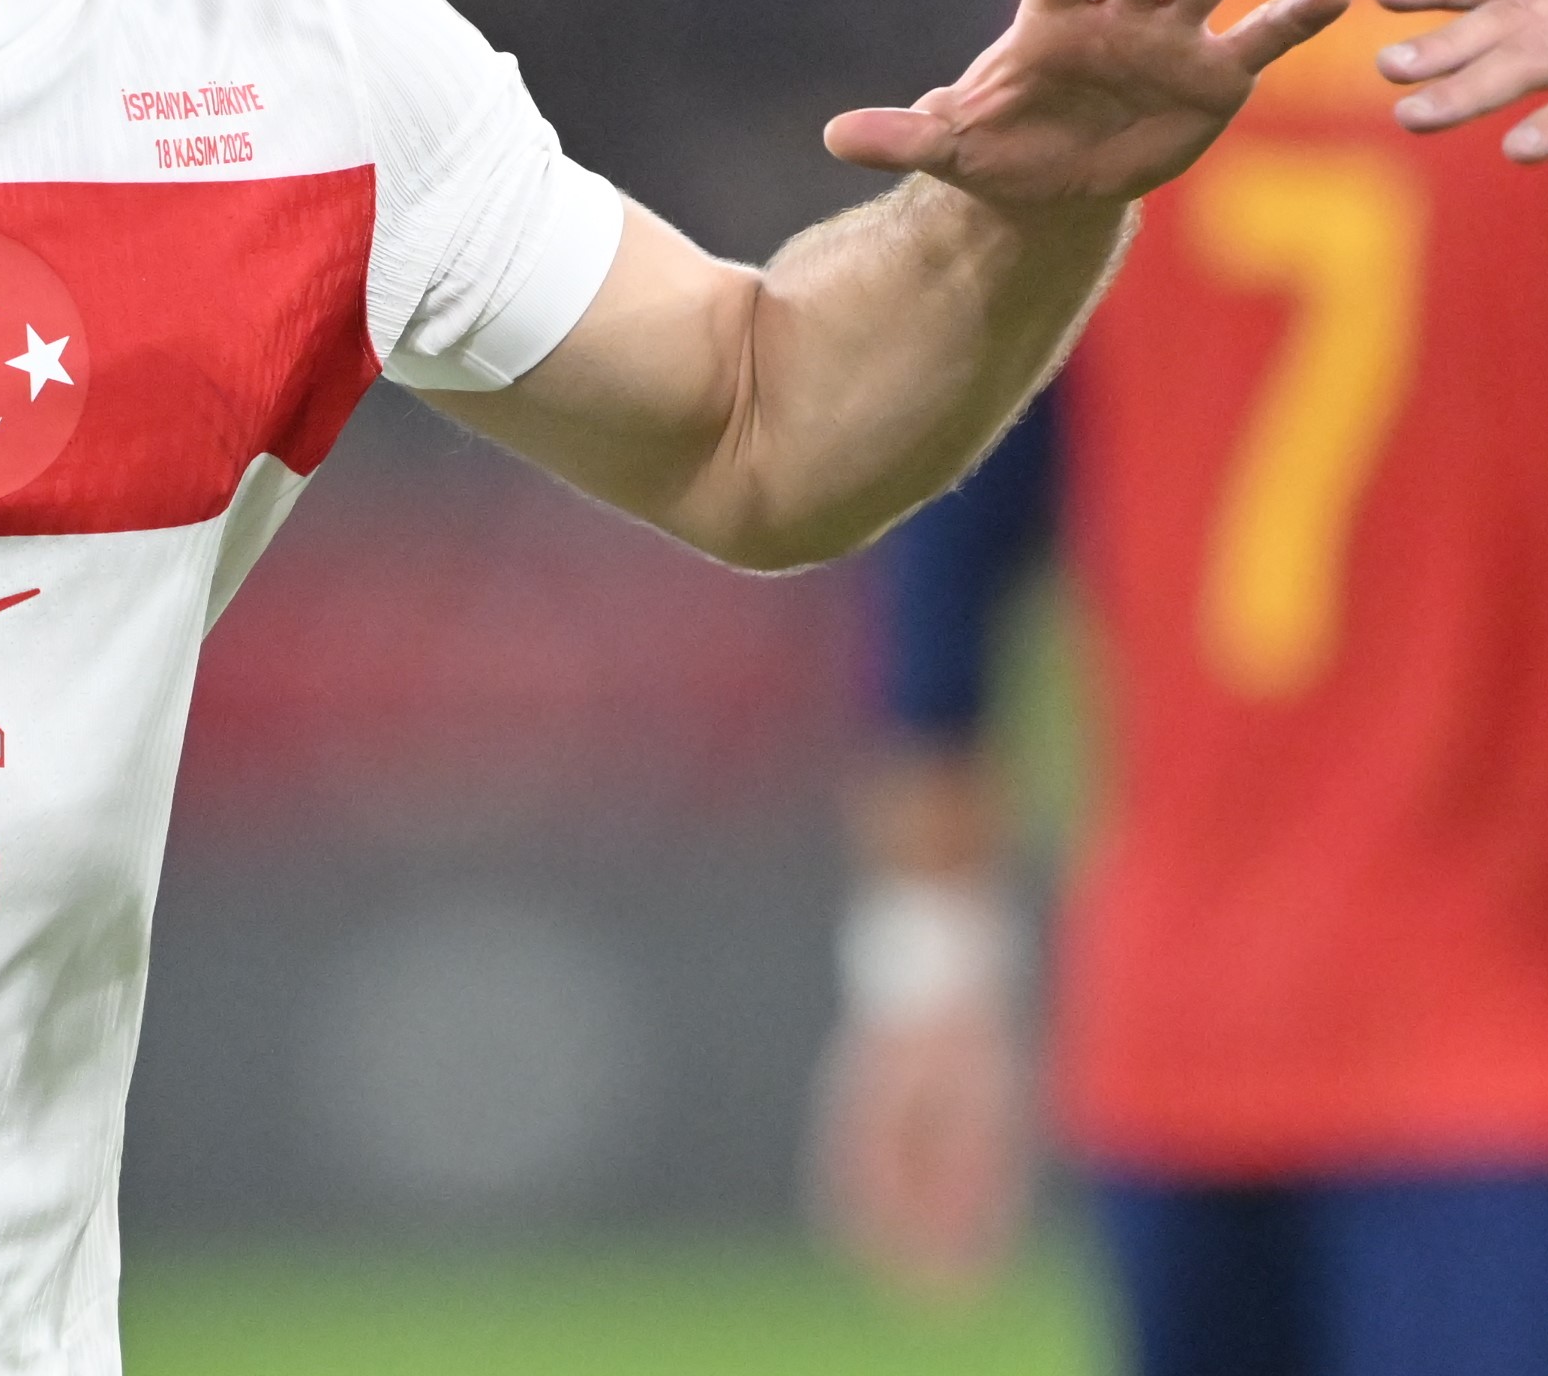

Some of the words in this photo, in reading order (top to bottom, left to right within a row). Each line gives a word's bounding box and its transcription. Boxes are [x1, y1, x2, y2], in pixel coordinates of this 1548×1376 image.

[121, 81, 264, 121] İSPANYA-TÜRKİYE
[155, 139, 172, 169] 18
[174, 135, 220, 168] KASIM
[219, 131, 253, 164] 2025
[1174, 139, 1429, 702] 7
